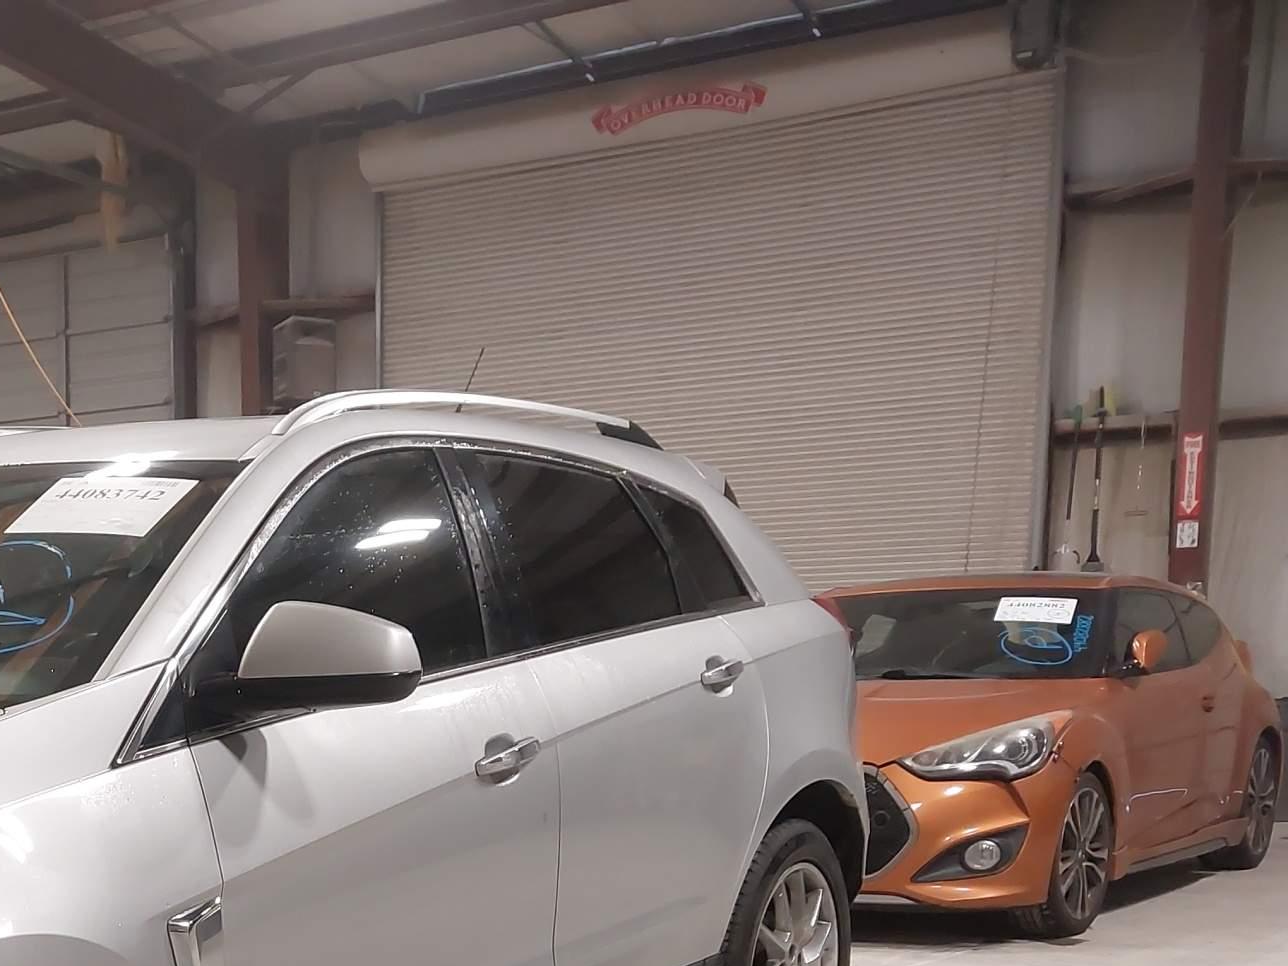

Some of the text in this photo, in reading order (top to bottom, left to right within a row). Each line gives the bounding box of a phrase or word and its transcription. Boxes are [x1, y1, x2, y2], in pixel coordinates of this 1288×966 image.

[611, 92, 746, 130] OVRHEAD DOOR
[55, 488, 167, 501] 44083742
